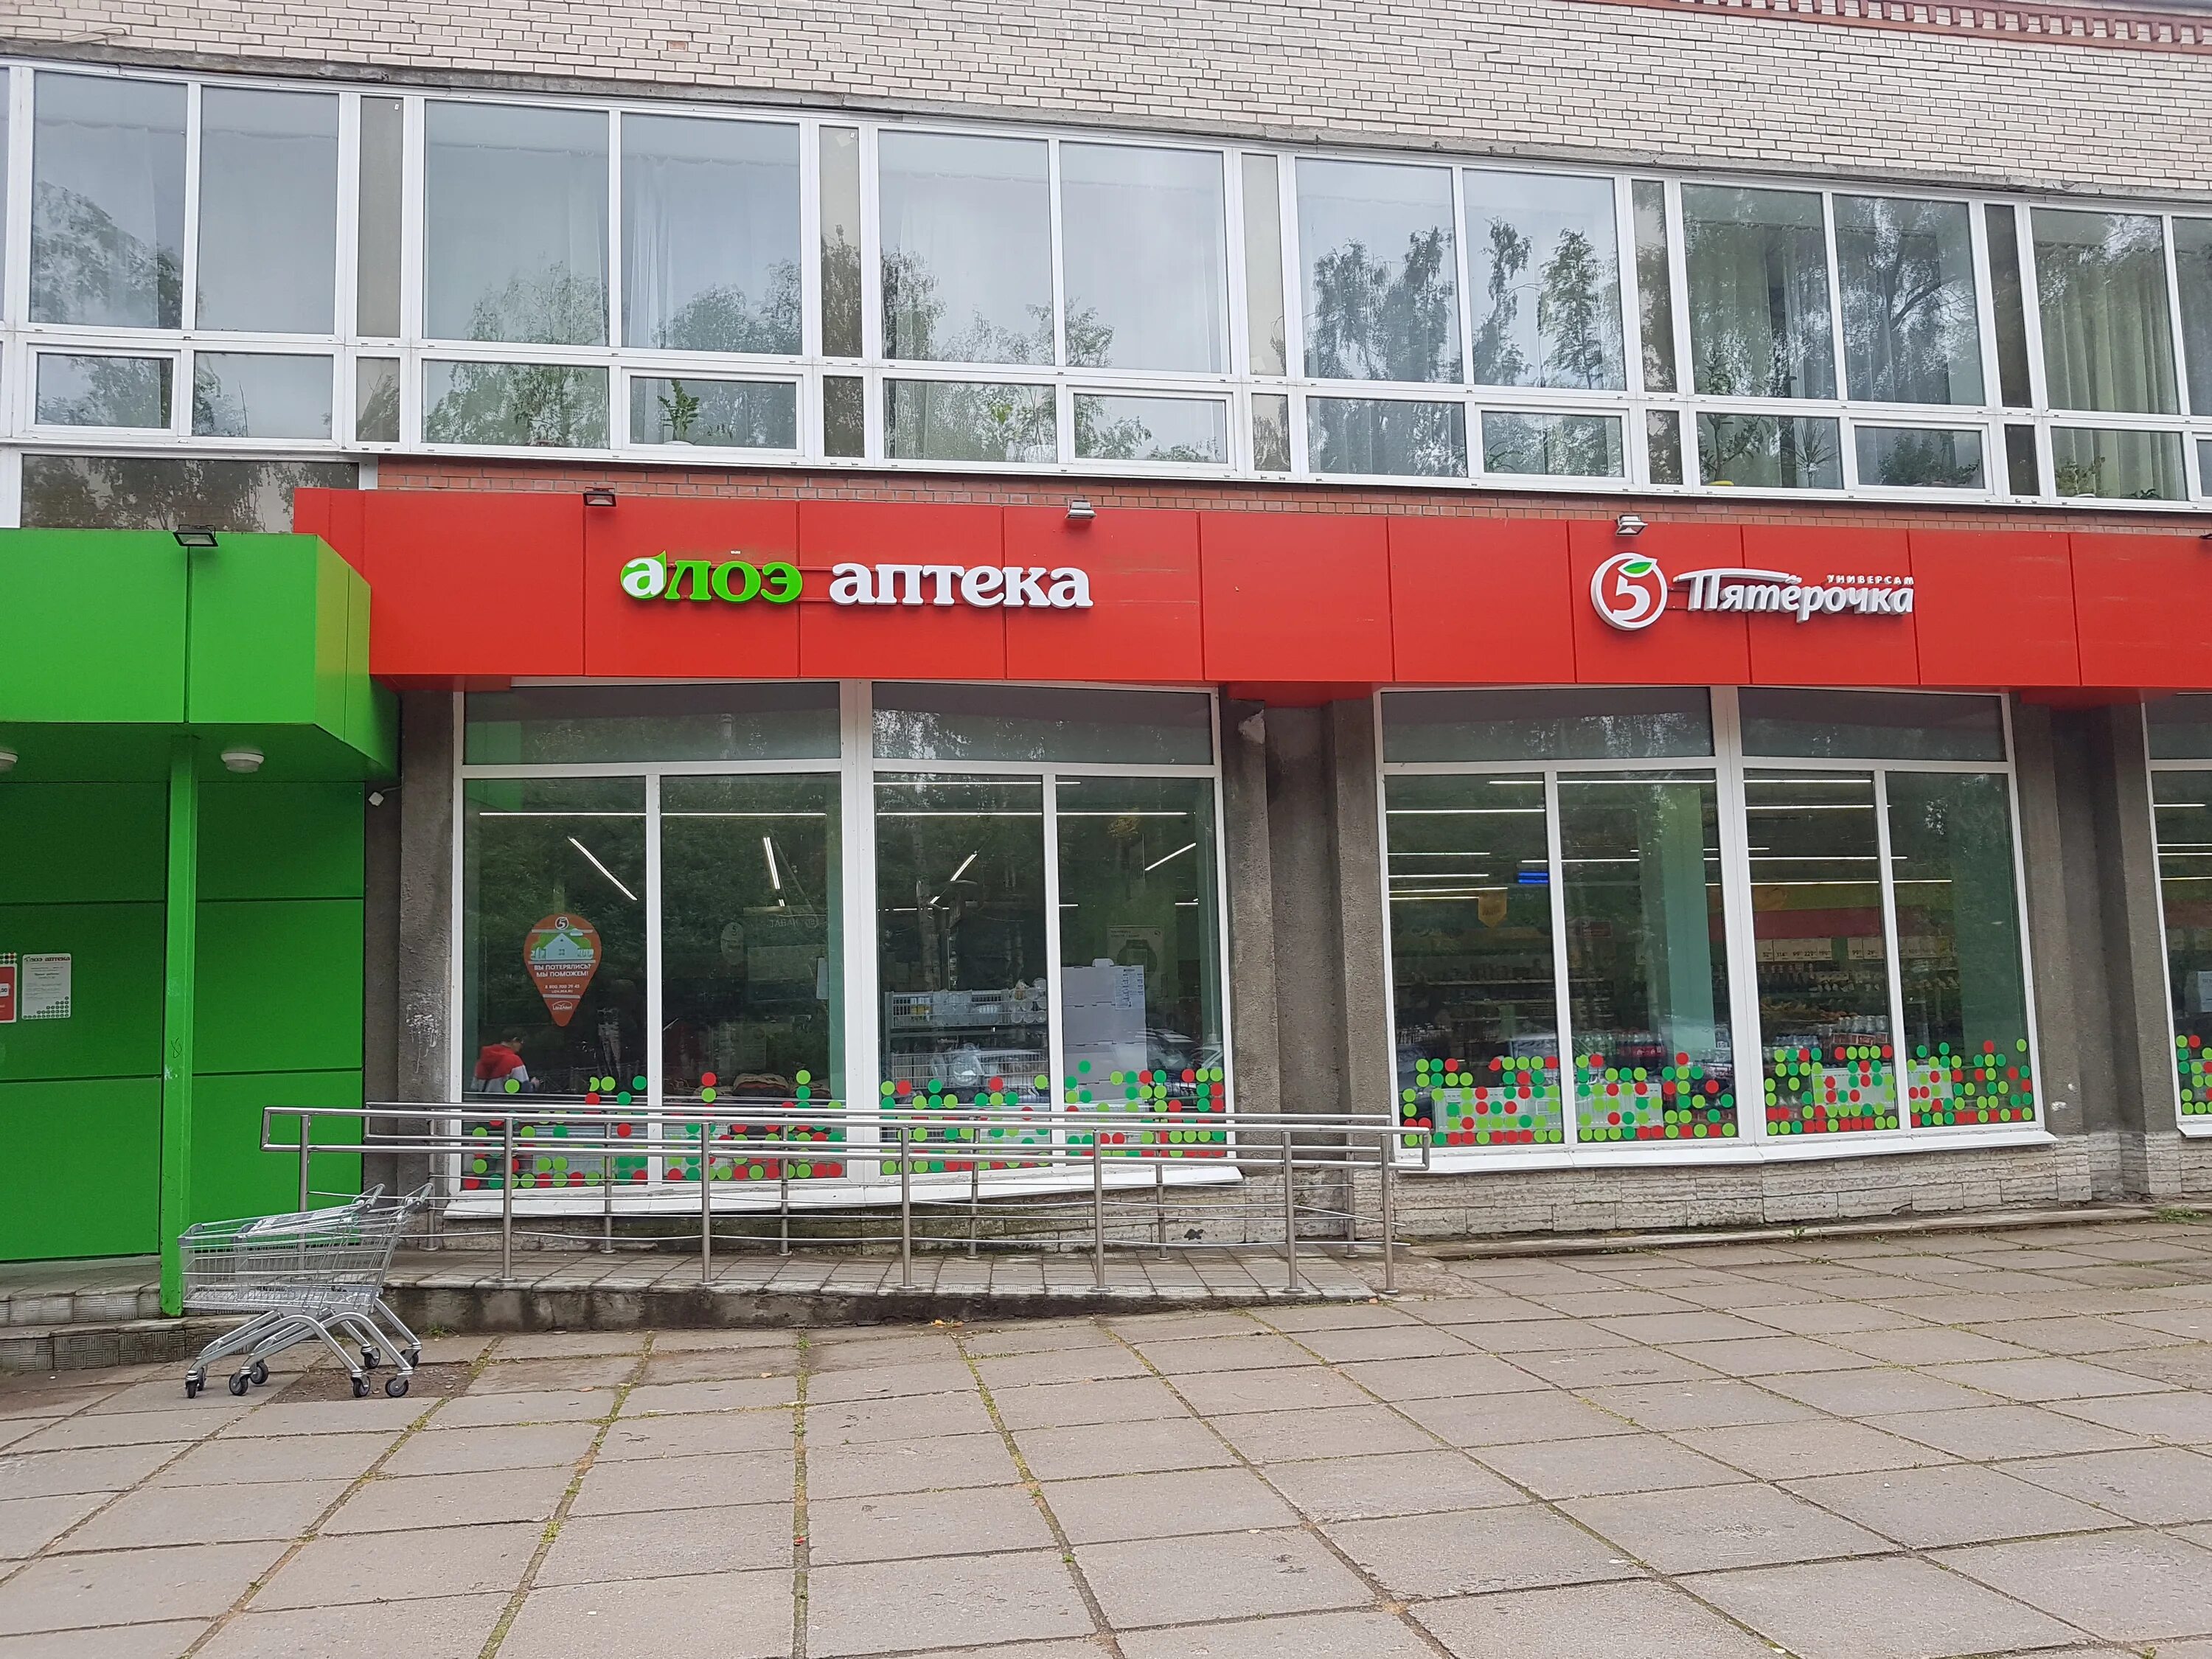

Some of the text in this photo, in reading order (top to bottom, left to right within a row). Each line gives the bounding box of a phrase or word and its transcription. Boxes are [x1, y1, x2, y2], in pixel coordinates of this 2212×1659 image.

[620, 550, 1093, 609] алоэ аптека
[1826, 574, 1915, 585] УНИВЕРСАМ
